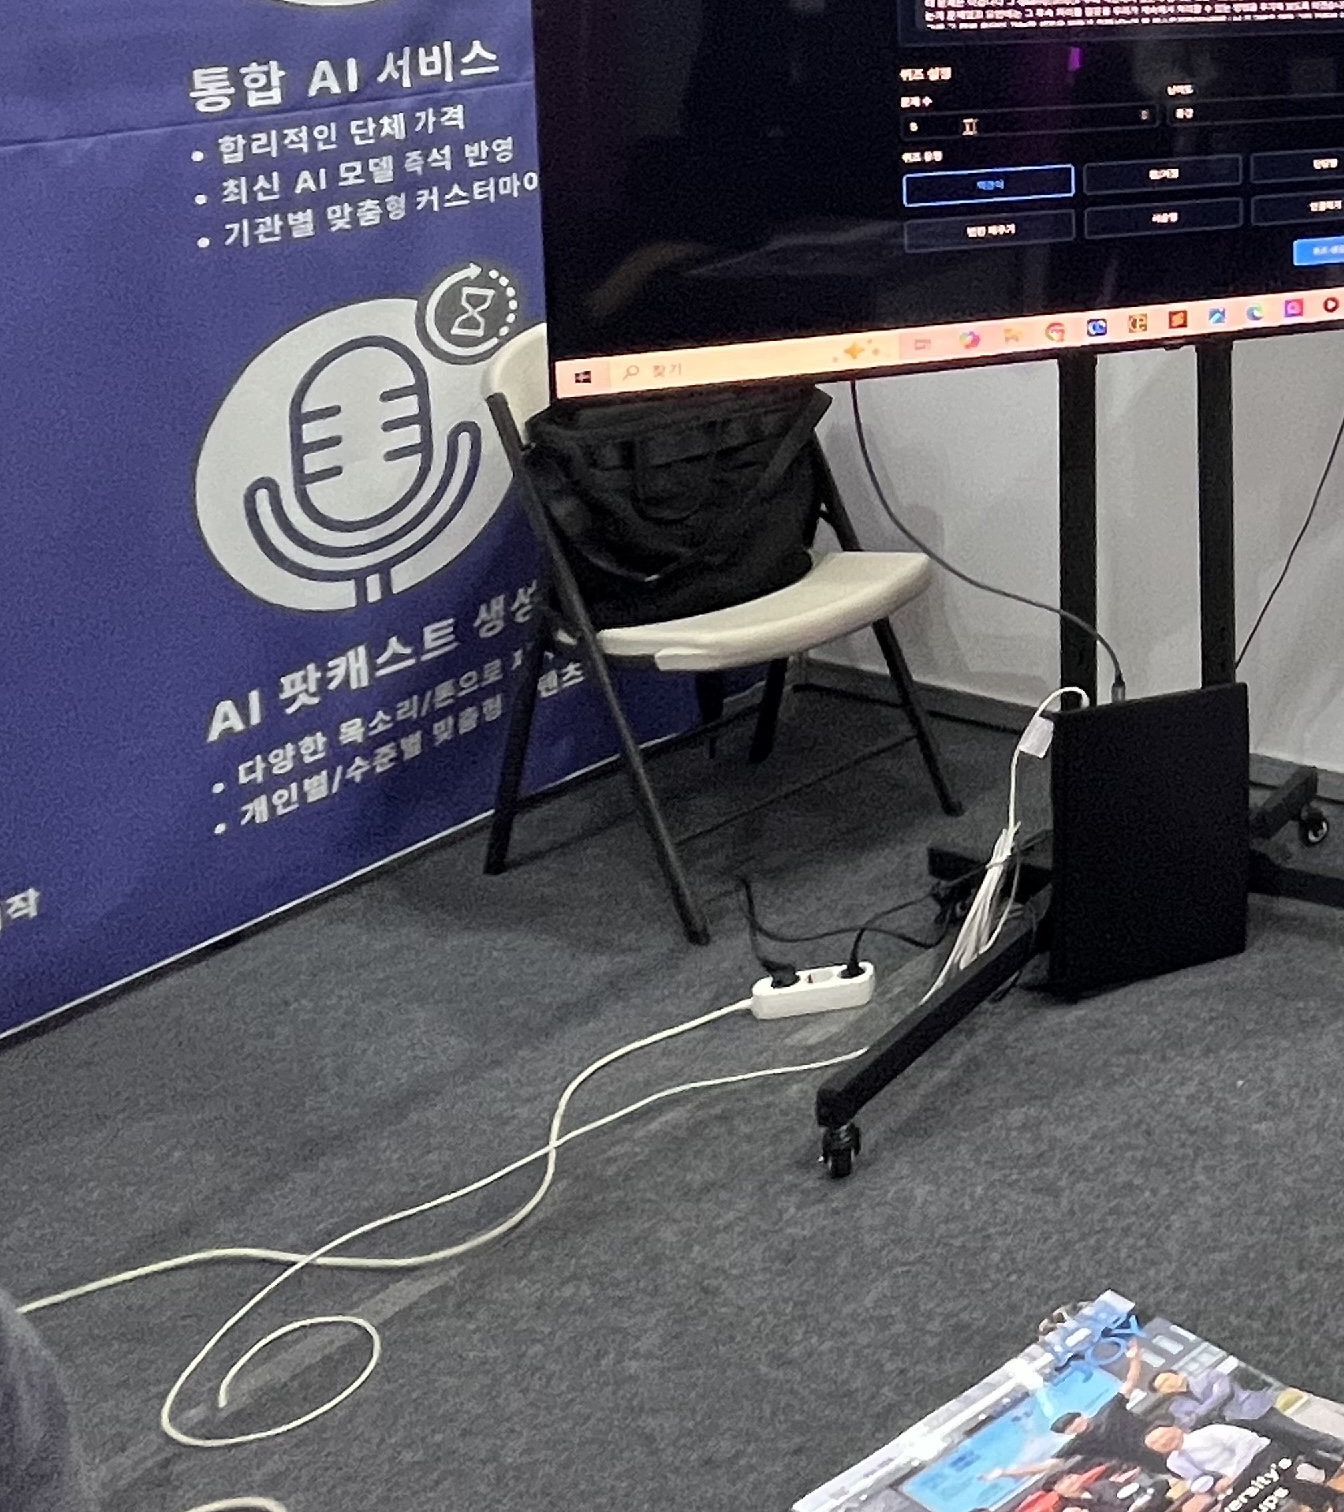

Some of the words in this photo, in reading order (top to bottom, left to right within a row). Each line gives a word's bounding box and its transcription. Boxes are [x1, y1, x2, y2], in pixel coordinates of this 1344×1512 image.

[189, 59, 286, 114] 통합
[307, 57, 359, 98] AI
[376, 40, 500, 89] 서비스
[218, 122, 339, 166] 합리적인
[349, 112, 407, 147] 단체
[413, 104, 466, 136] 가격
[221, 171, 281, 206] 최신
[294, 168, 327, 195] AI
[338, 154, 395, 188] 모델
[464, 136, 515, 168] 반영
[224, 207, 317, 249] 기관별
[325, 192, 408, 234] 맞춤형
[206, 688, 262, 744] AI
[279, 617, 460, 716] 팟캐스트
[237, 731, 328, 785] 다양한
[239, 731, 424, 826] 개인별/수준별
